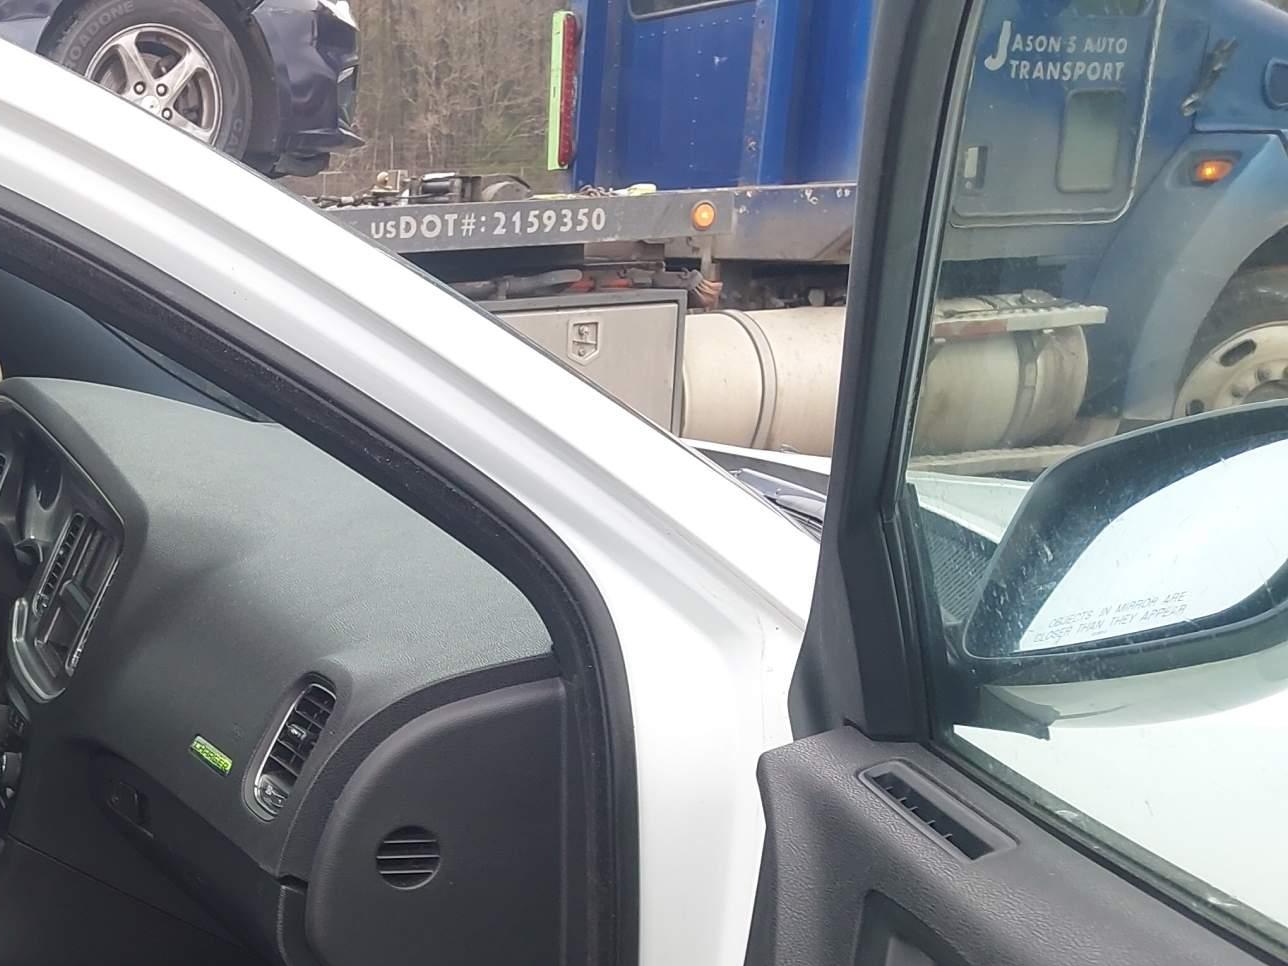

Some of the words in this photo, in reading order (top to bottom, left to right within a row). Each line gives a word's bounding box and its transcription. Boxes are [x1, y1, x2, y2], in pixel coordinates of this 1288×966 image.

[1083, 36, 1128, 54] AUTO
[1009, 59, 1125, 81] TRANSPORT
[493, 207, 606, 235] 2159350
[1048, 609, 1094, 628] OBJECTS
[1099, 605, 1112, 617] IN
[1116, 597, 1159, 613] MIRROR
[1164, 591, 1187, 603] ARE
[1078, 619, 1105, 632] THAN
[1111, 613, 1137, 626] THEY
[1141, 604, 1187, 620] APPEAR
